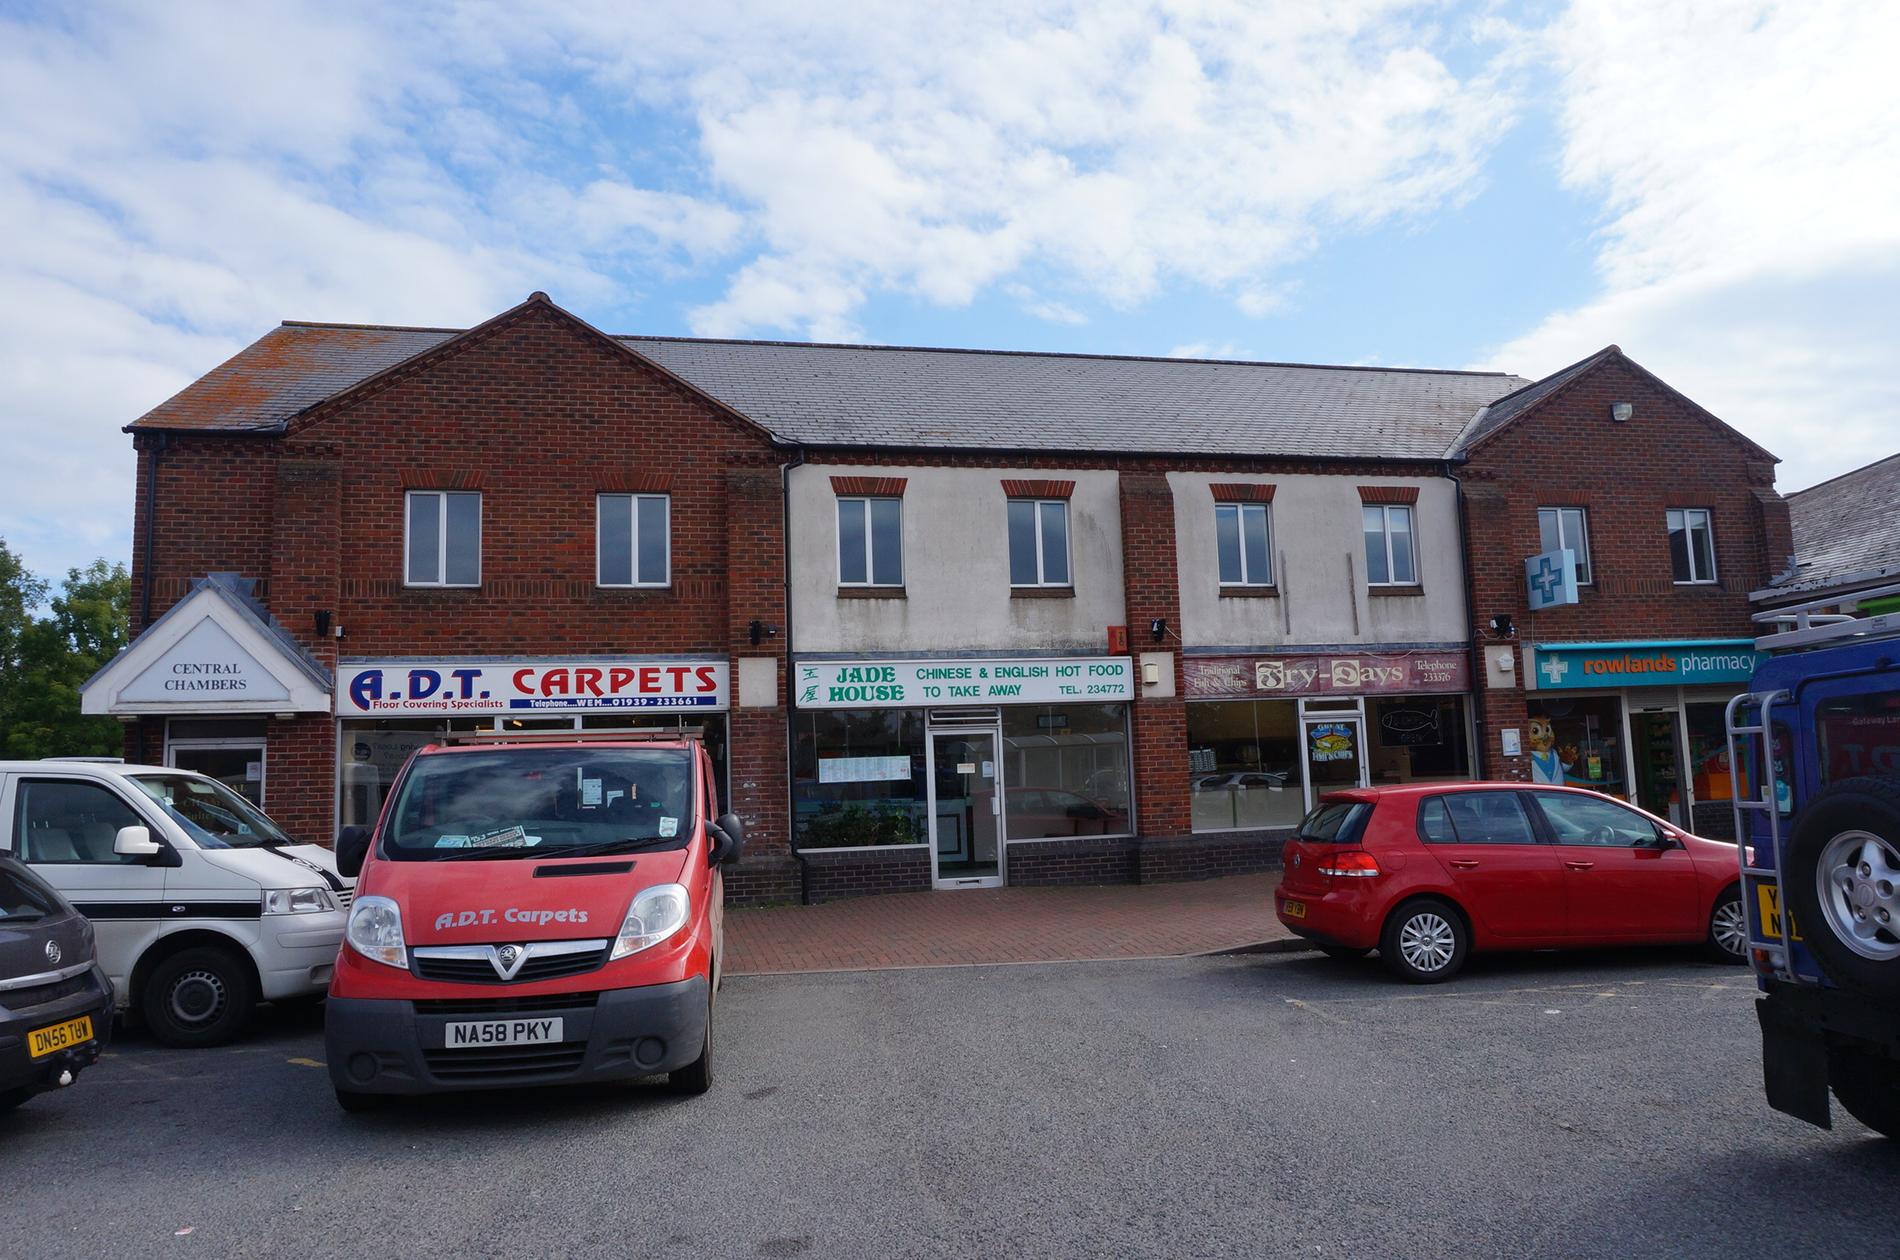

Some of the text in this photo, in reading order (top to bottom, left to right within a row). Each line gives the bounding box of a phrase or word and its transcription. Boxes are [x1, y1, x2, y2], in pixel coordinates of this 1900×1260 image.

[172, 664, 242, 675] CENTRAL
[1198, 664, 1241, 676] Traditional
[1415, 660, 1457, 671] Telephone
[1584, 652, 1756, 676] rowlands pharmacy
[836, 666, 897, 683] JADE
[916, 664, 1124, 680] CHINESE & ENGLISH HOT FOOD
[164, 679, 247, 690] CHAMBERS
[349, 667, 717, 712] A.D.T. CARPETS
[1224, 676, 1247, 689] Chips
[828, 684, 905, 702] HOUSE
[923, 686, 940, 697] TO
[948, 685, 981, 697] TAKE
[988, 684, 1022, 696] AWAY
[1087, 684, 1125, 694] 234772
[373, 700, 504, 710] Floor Covering Specialists
[656, 697, 698, 705] 233661
[435, 908, 588, 931] A.D.T. Carpets
[35, 1019, 89, 1051] DN56 TUW
[454, 1021, 553, 1044] NA58 PKY
